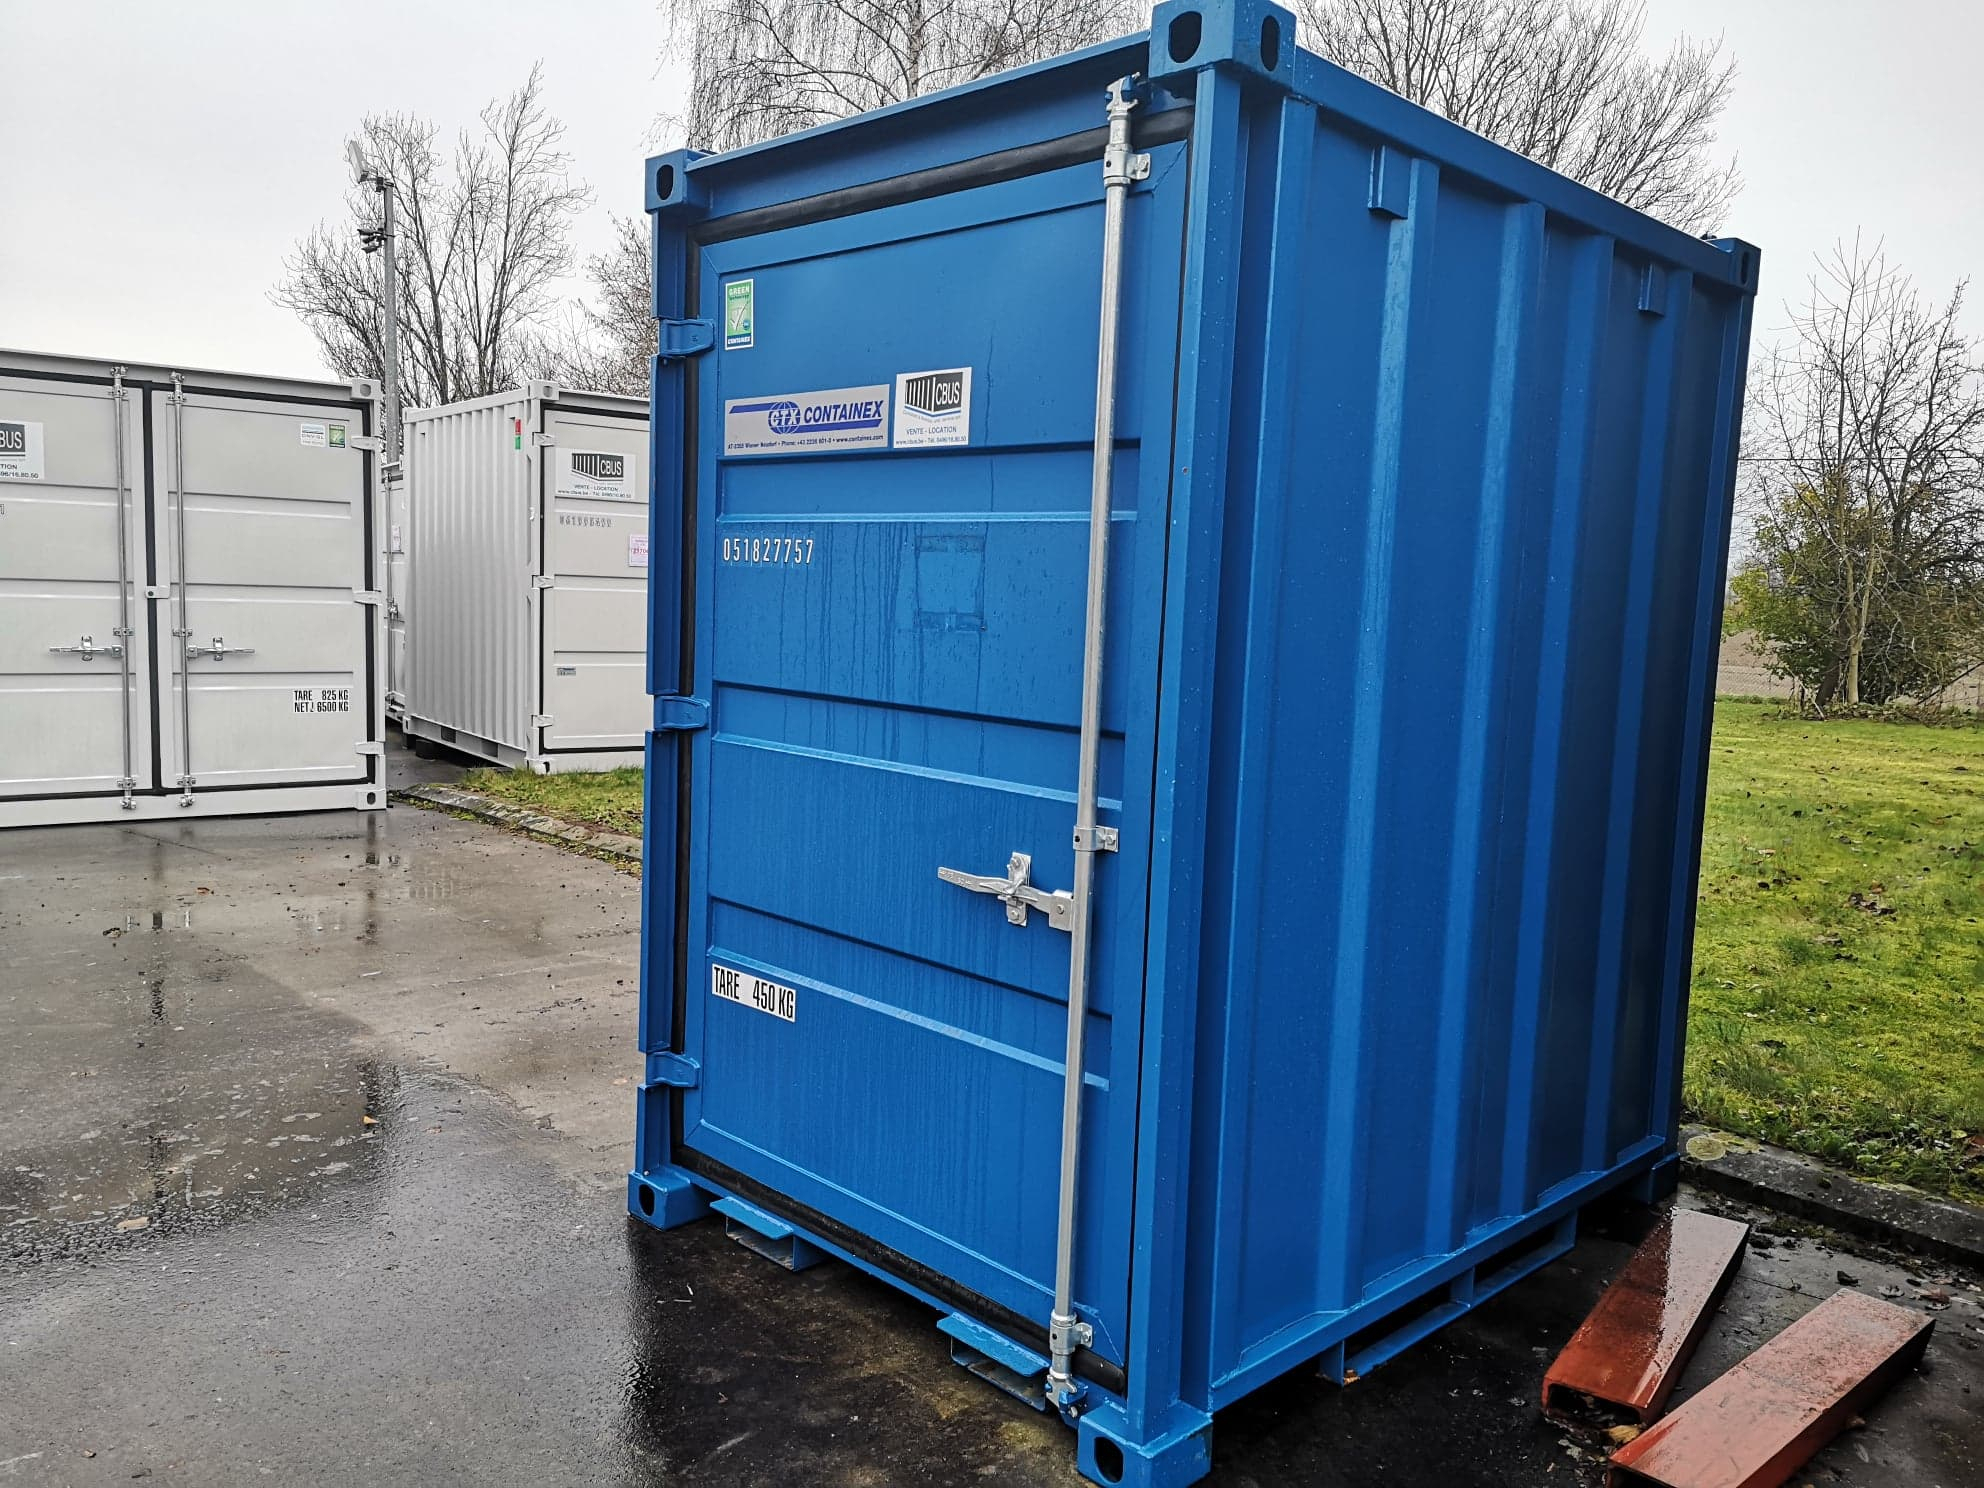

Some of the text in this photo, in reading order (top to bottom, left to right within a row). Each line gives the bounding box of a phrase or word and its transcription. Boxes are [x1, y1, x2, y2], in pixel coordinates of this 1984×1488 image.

[729, 285, 750, 295] GREEN
[936, 381, 961, 405] CBUS
[771, 409, 798, 426] CTX
[804, 400, 883, 424] CONTAINEX
[928, 426, 957, 434] LOCATION
[600, 460, 622, 476] CBUS
[723, 538, 814, 564] 051827757
[294, 689, 349, 701] TARE 825 KG
[317, 701, 337, 712] 6500
[338, 701, 349, 712] KG
[714, 966, 794, 1018] TARE 450 KG
